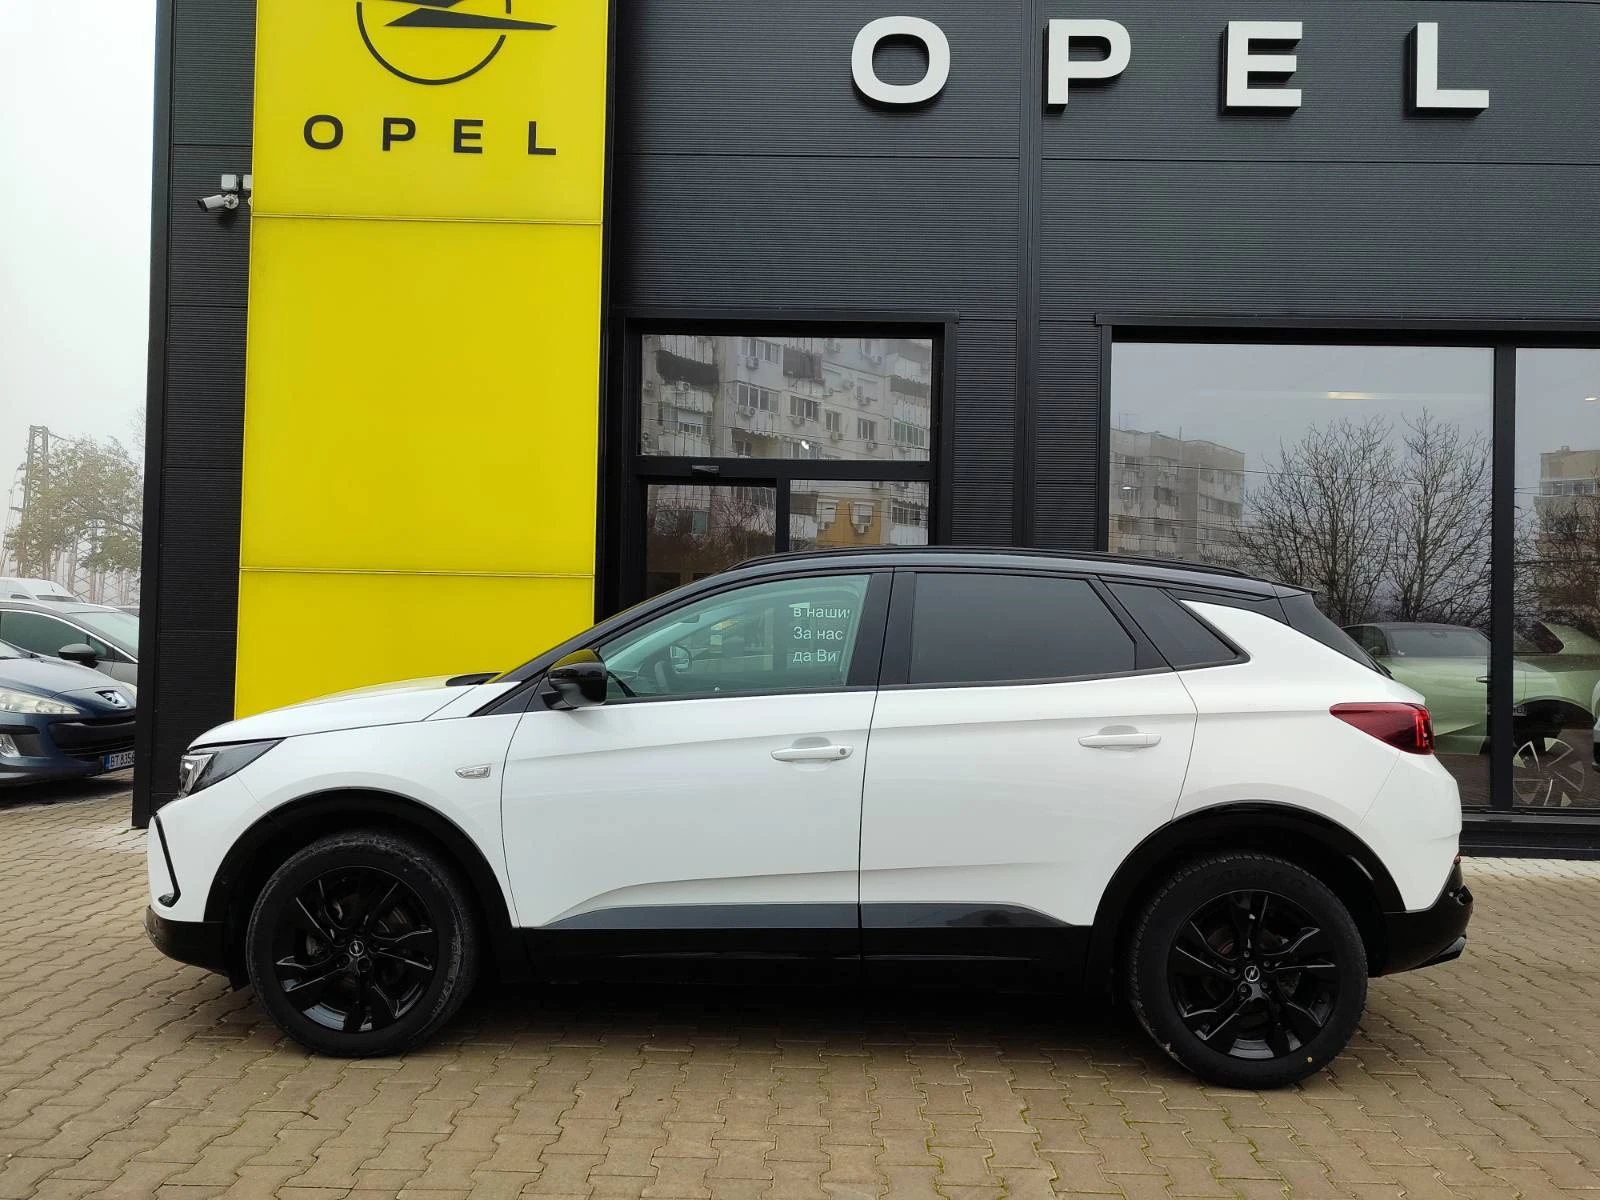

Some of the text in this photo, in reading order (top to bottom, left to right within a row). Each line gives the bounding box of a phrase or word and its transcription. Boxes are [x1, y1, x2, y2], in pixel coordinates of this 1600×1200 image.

[851, 15, 1490, 109] OPEL
[303, 114, 557, 155] OPEL
[793, 626, 843, 640] За нас
[792, 649, 836, 663] да Ви
